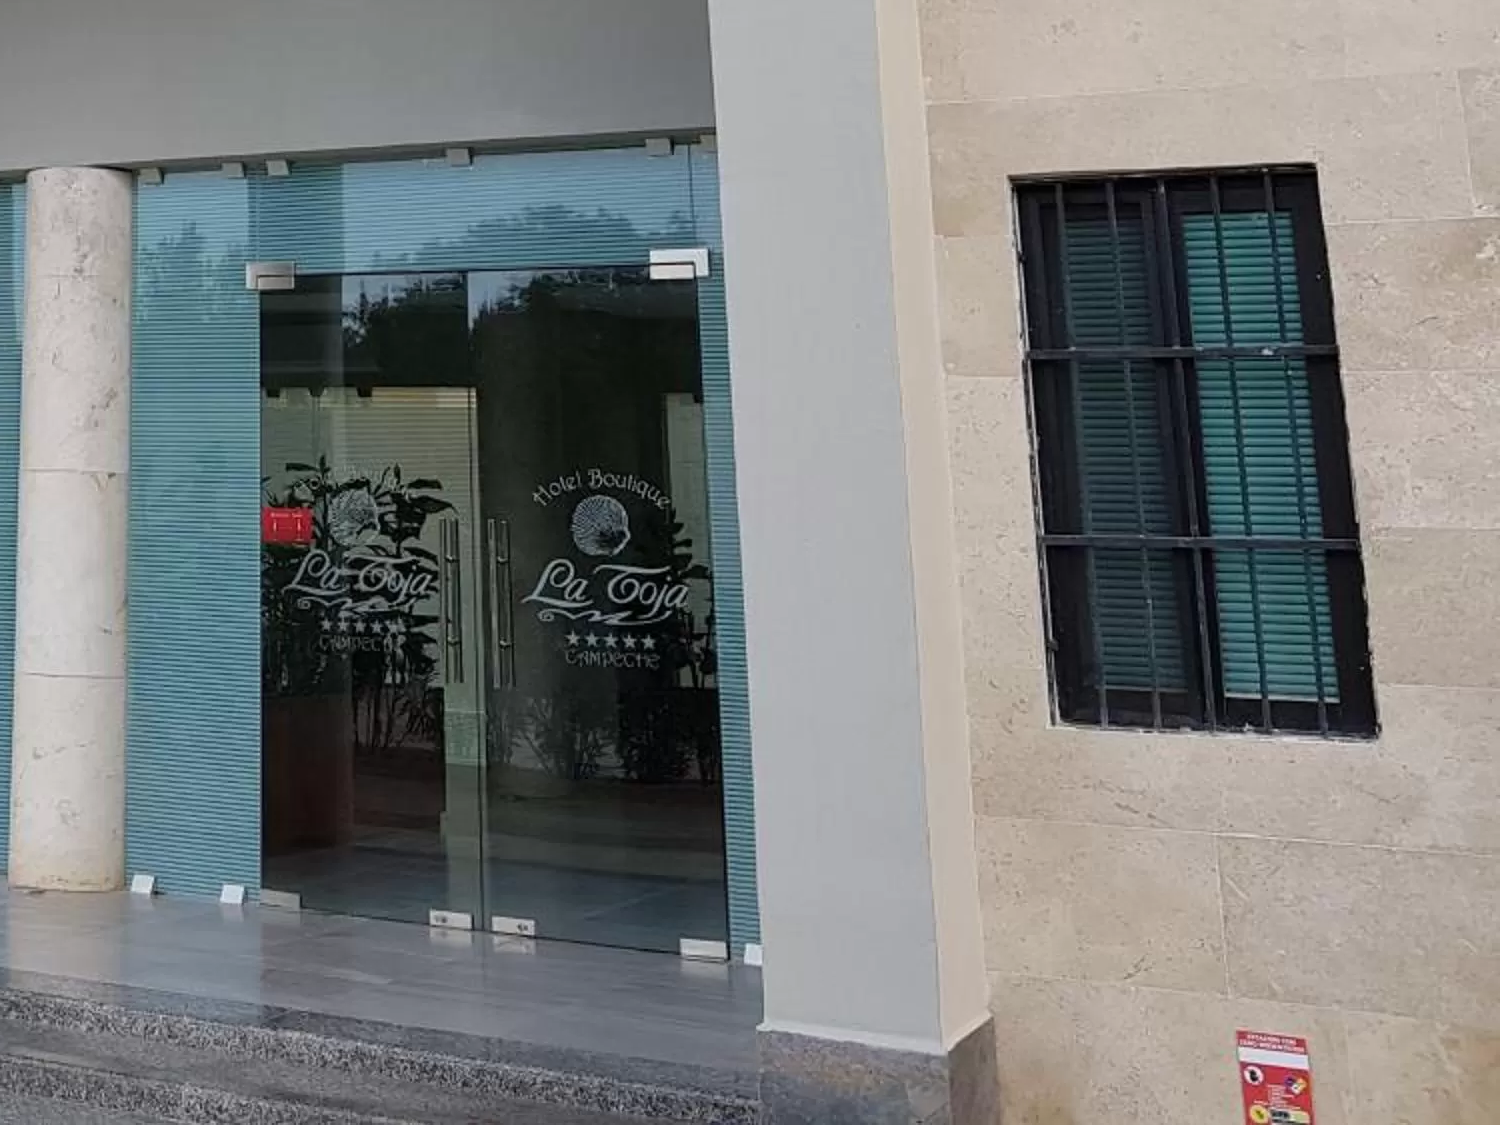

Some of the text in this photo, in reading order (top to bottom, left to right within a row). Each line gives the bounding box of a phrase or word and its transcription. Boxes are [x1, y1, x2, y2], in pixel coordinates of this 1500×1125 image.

[532, 468, 671, 510] Hotel Boutique
[281, 549, 349, 596] La
[520, 558, 689, 619] La Toja
